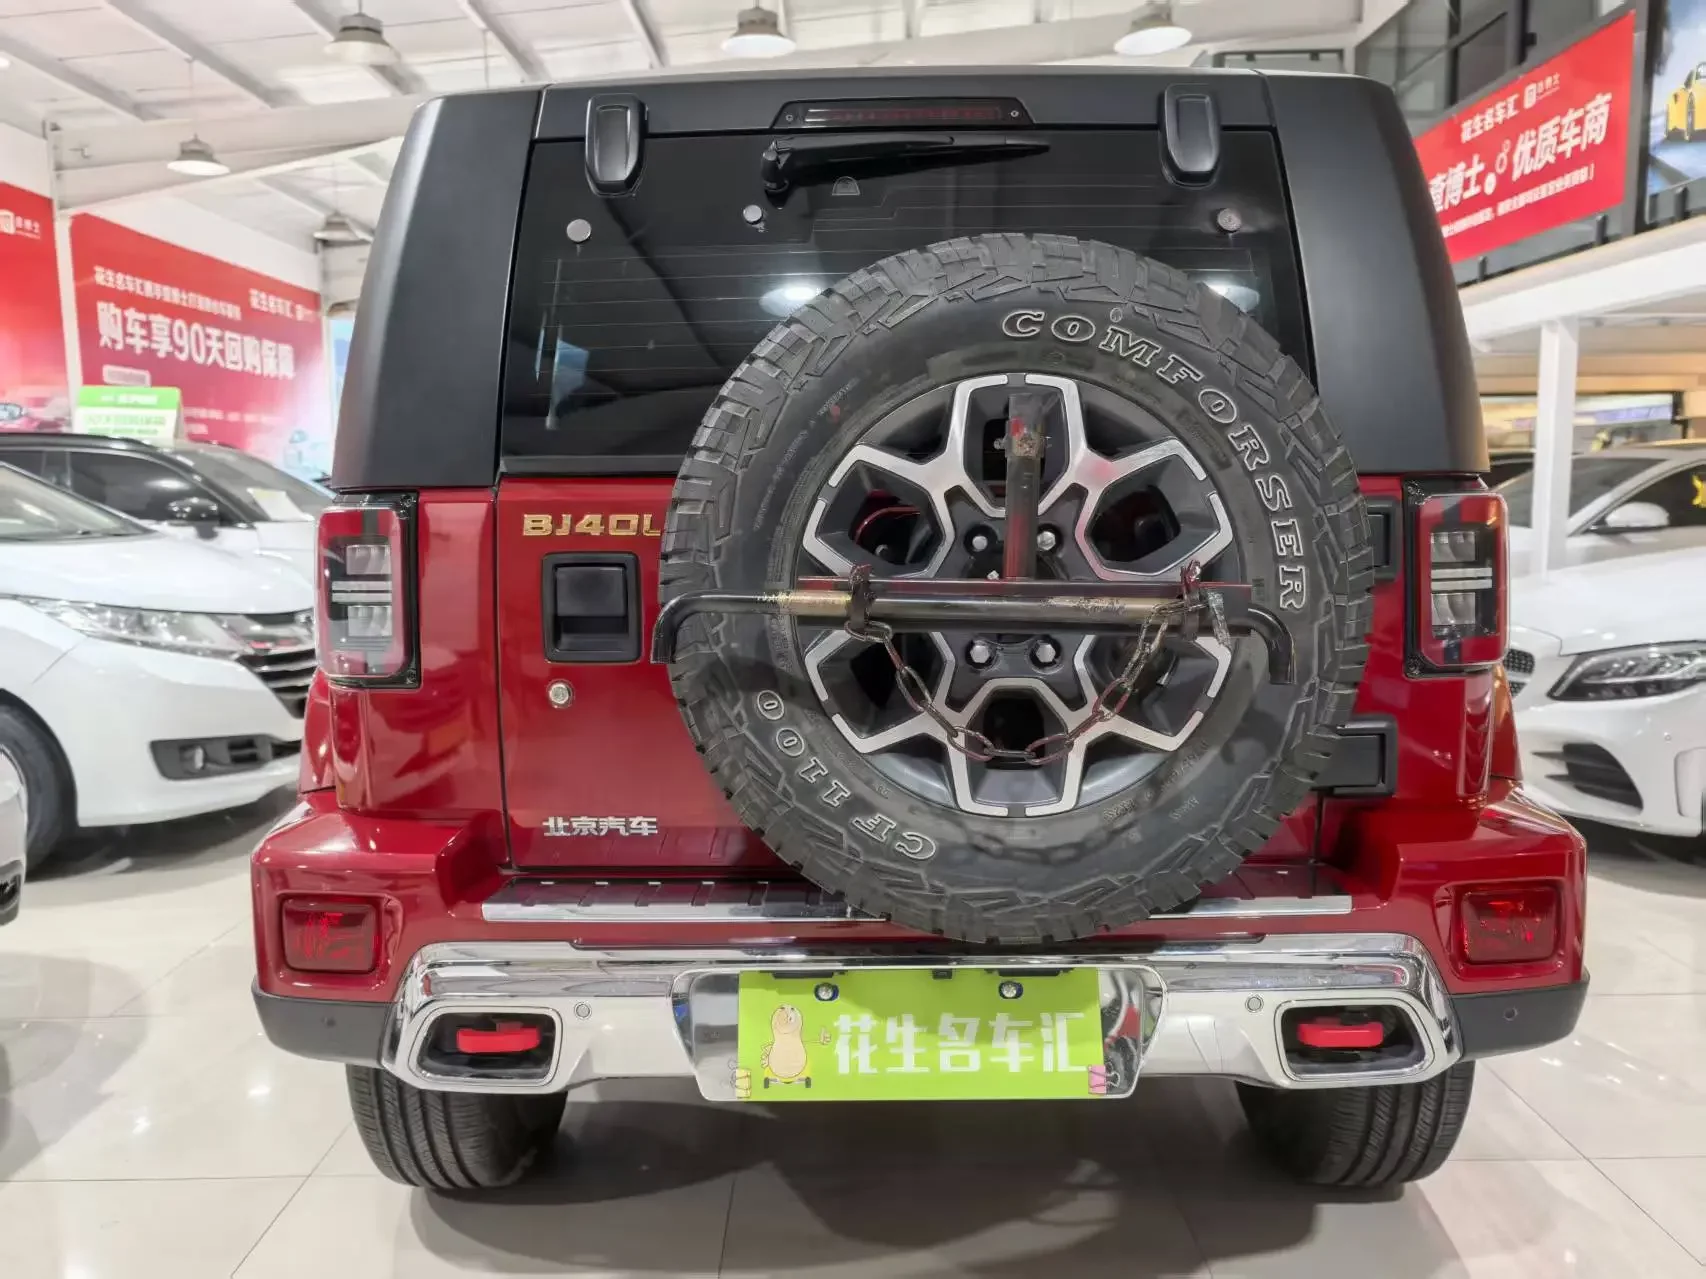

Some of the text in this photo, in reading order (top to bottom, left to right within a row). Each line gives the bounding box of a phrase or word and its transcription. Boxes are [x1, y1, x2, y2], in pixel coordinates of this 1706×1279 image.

[1512, 92, 1612, 181] 优质车商
[1002, 310, 1306, 612] COMFORSER
[523, 514, 661, 536] BJ40L
[542, 816, 658, 837] 北京汽车
[834, 1012, 1091, 1075] 花生名车汇
